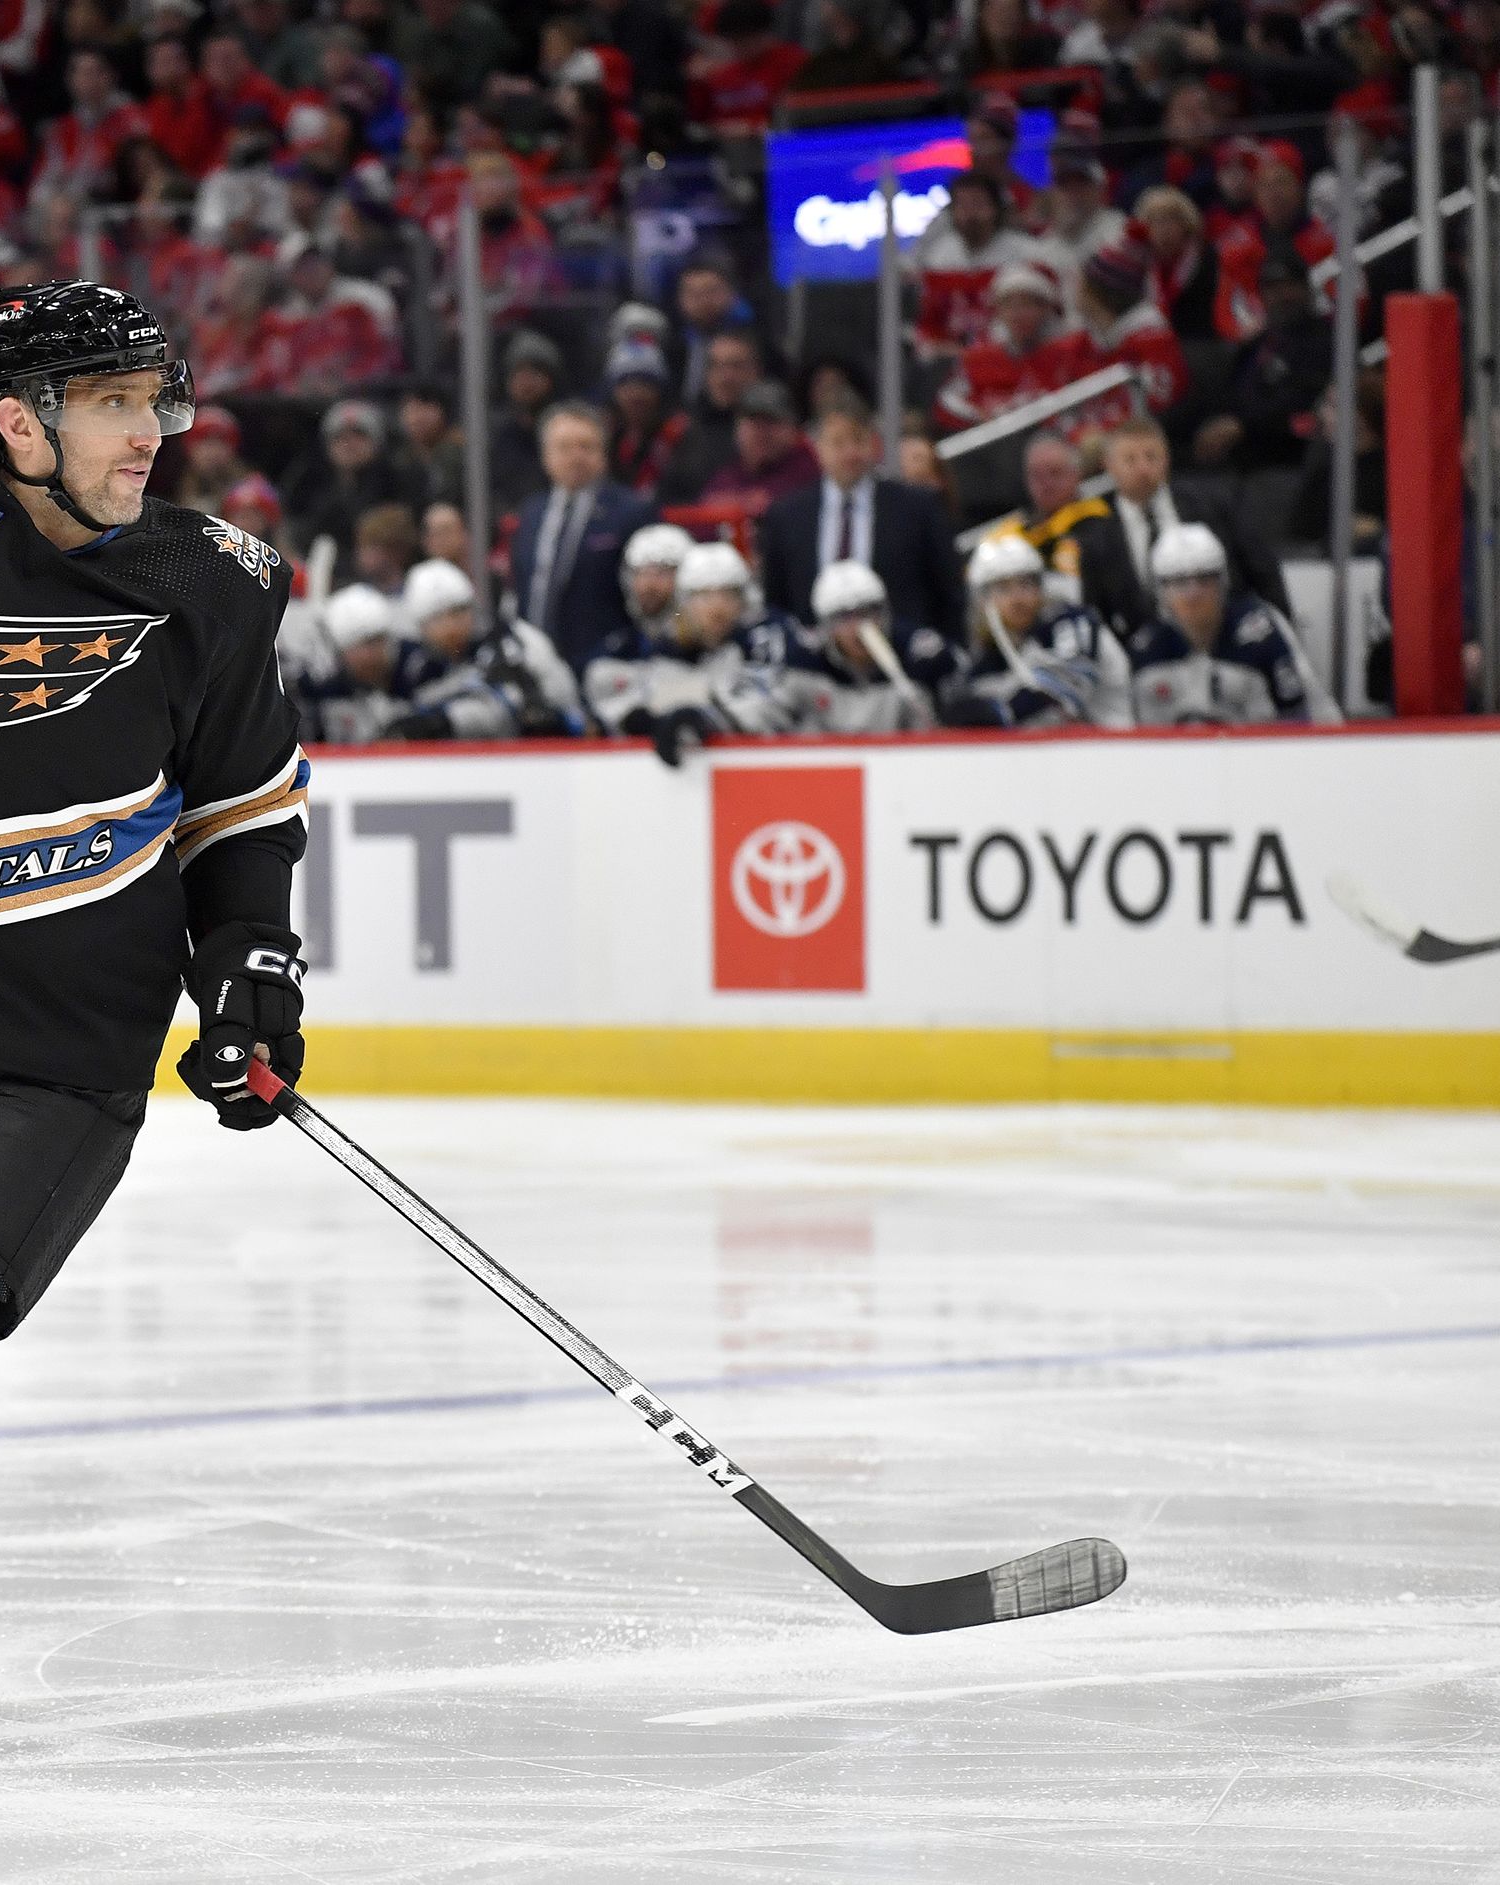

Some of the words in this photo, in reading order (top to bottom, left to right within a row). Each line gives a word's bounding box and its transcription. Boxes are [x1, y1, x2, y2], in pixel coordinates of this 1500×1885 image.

[127, 326, 159, 340] CCM
[303, 800, 513, 971] IT
[909, 830, 1306, 925] TOYOTA
